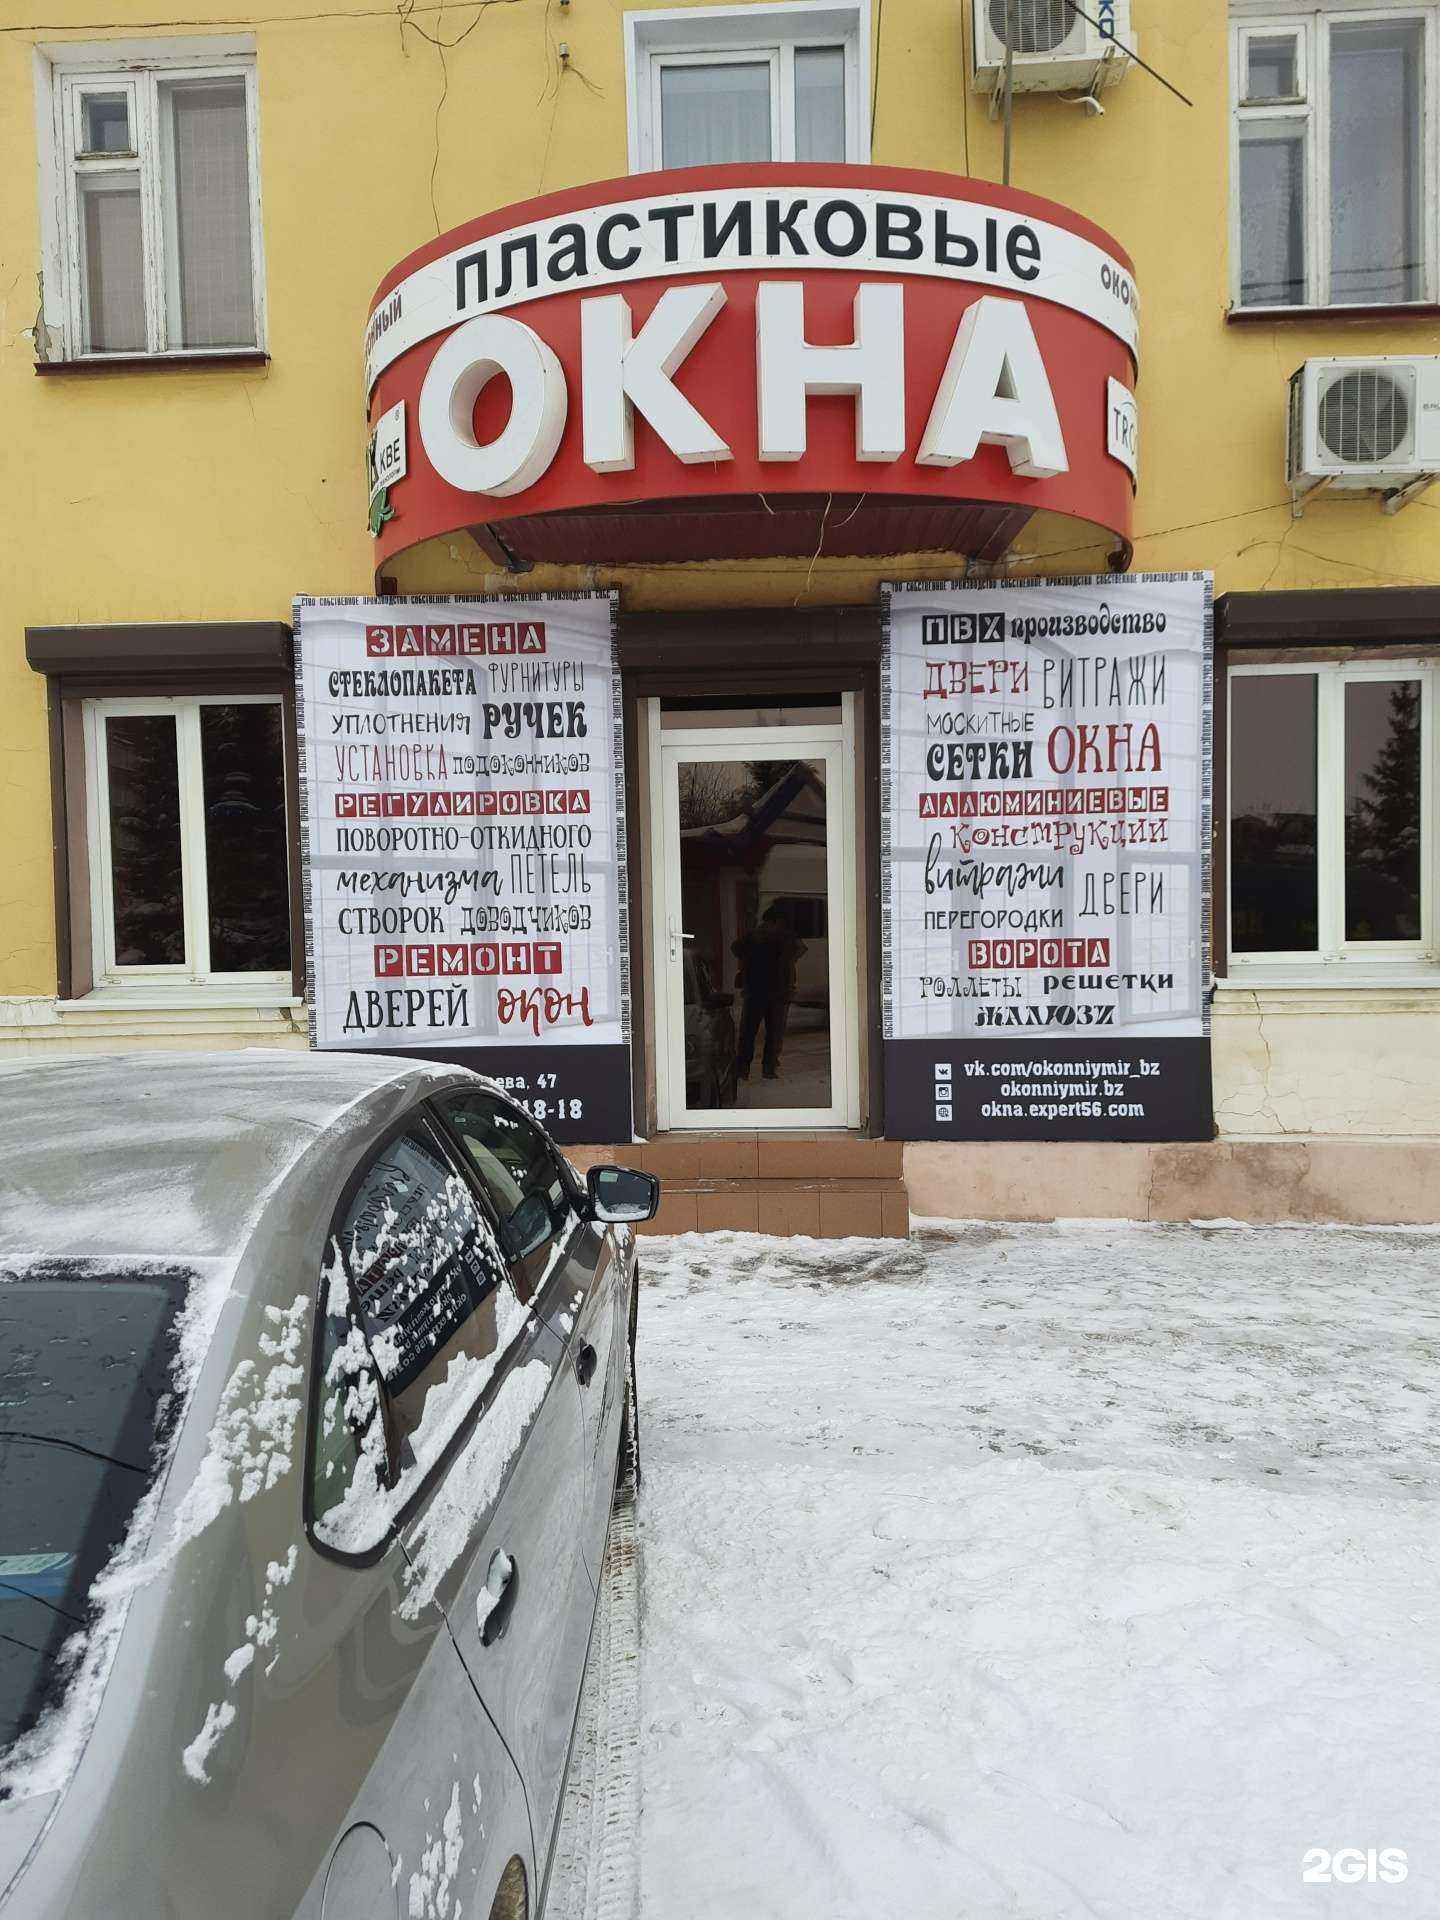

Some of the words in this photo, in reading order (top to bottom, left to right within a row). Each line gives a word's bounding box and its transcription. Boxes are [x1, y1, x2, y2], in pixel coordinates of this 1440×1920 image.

[418, 281, 1069, 497] ОКНА
[367, 622, 546, 657] ЗАМЕНА
[922, 612, 1005, 645] ПВХ
[1011, 602, 1167, 644] производство
[328, 668, 477, 698] СТЕКЛОПАКЕТА
[487, 661, 585, 693] ФУРНИТУРЫ
[923, 660, 1029, 700] ДВЕРИ
[1043, 655, 1166, 709] ВИТРАЖИ
[481, 701, 588, 740] РУЧЕК
[926, 712, 1035, 736] МОСКИТНЫЕ
[334, 743, 449, 782] УСТАНОВКА
[452, 752, 590, 777] ПОДОКОННИКОВ
[926, 741, 1034, 782] СЕТКИ
[1047, 722, 1162, 775] ОКНА
[335, 789, 591, 817] РЕГУЛИРОВКА
[336, 824, 592, 852] ПОВОРОТНО-ОТКИДНОГО
[336, 869, 504, 905] механизма
[510, 853, 591, 894] ПЕТЕЛЬ
[924, 832, 1065, 899] витражи
[1078, 872, 1163, 917] ДВЕРИ
[338, 906, 445, 935] СТВОРОК
[460, 904, 591, 935] ДОВОДЧИКОВ
[924, 909, 1064, 932] ПЕРЕГОРОДКИ
[374, 942, 562, 977] РЕМОНТ
[968, 938, 1110, 969] ВОРОТА
[920, 976, 1023, 999] РОЛЛЕТЫ
[342, 983, 469, 1033] ДВЕРЕЙ
[498, 986, 594, 1036] окон
[974, 1005, 1116, 1027] ЖАЛЮЗИ
[537, 1073, 557, 1089] 47
[963, 1059, 1161, 1079] vk.com/okonniymir_bz
[1000, 1080, 1125, 1099] okonniymir.bz
[981, 1100, 1145, 1119] okna.expert56.com
